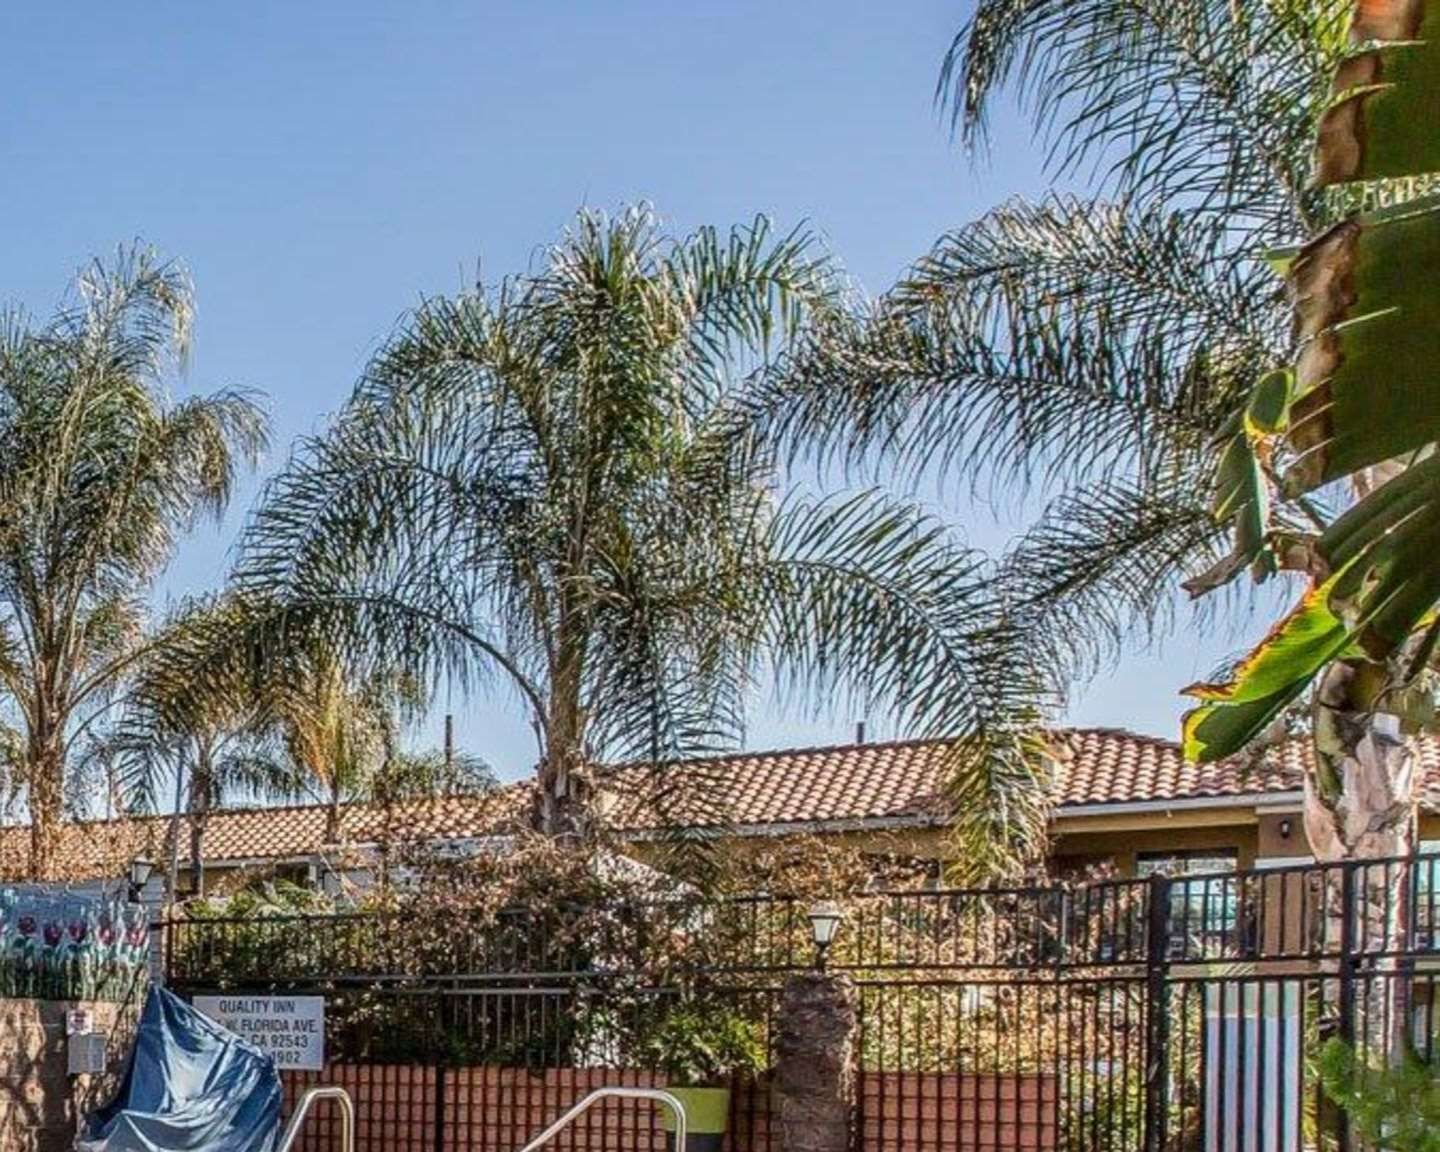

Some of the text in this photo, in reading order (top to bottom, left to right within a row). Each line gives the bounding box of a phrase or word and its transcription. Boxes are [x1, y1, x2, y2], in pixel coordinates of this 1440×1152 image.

[219, 999, 296, 1013] QUALITY INN
[241, 1019, 289, 1032] FLORIDA
[251, 1034, 309, 1049] CA 92543
